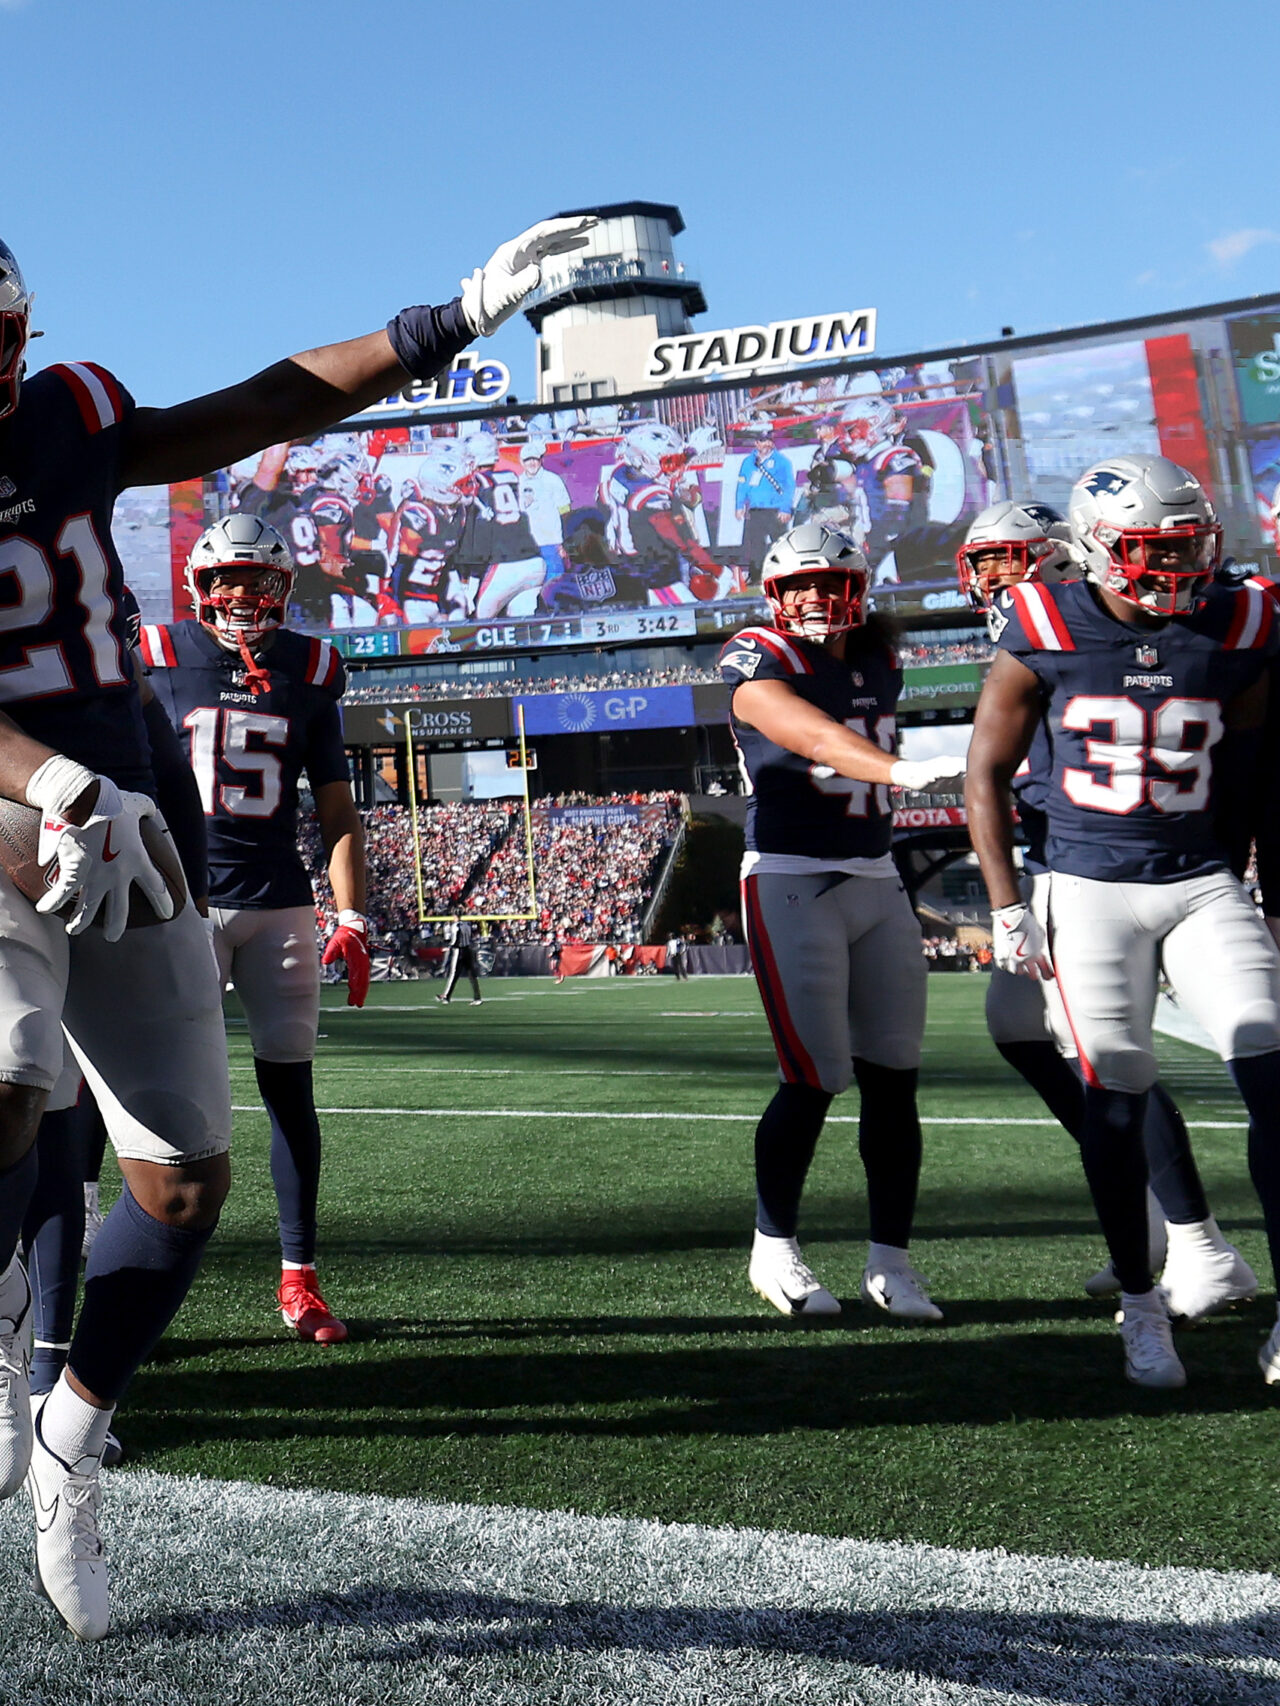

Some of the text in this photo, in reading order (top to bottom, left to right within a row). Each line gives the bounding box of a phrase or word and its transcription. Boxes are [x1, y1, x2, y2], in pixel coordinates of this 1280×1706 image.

[651, 317, 868, 377] STADIUM
[584, 580, 614, 597] NFL
[541, 625, 553, 642] 7
[596, 622, 620, 637] 3RD
[637, 616, 680, 634] 3:42
[354, 636, 376, 654] 23
[476, 626, 517, 648] CLE
[1123, 675, 1174, 688] PATRIOTS
[220, 691, 257, 704] PATRIOTS
[909, 682, 975, 699] paycom
[408, 708, 472, 728] CROSS
[411, 726, 472, 737] NSURANCE
[183, 706, 292, 820] 15
[1061, 695, 1224, 815] 39
